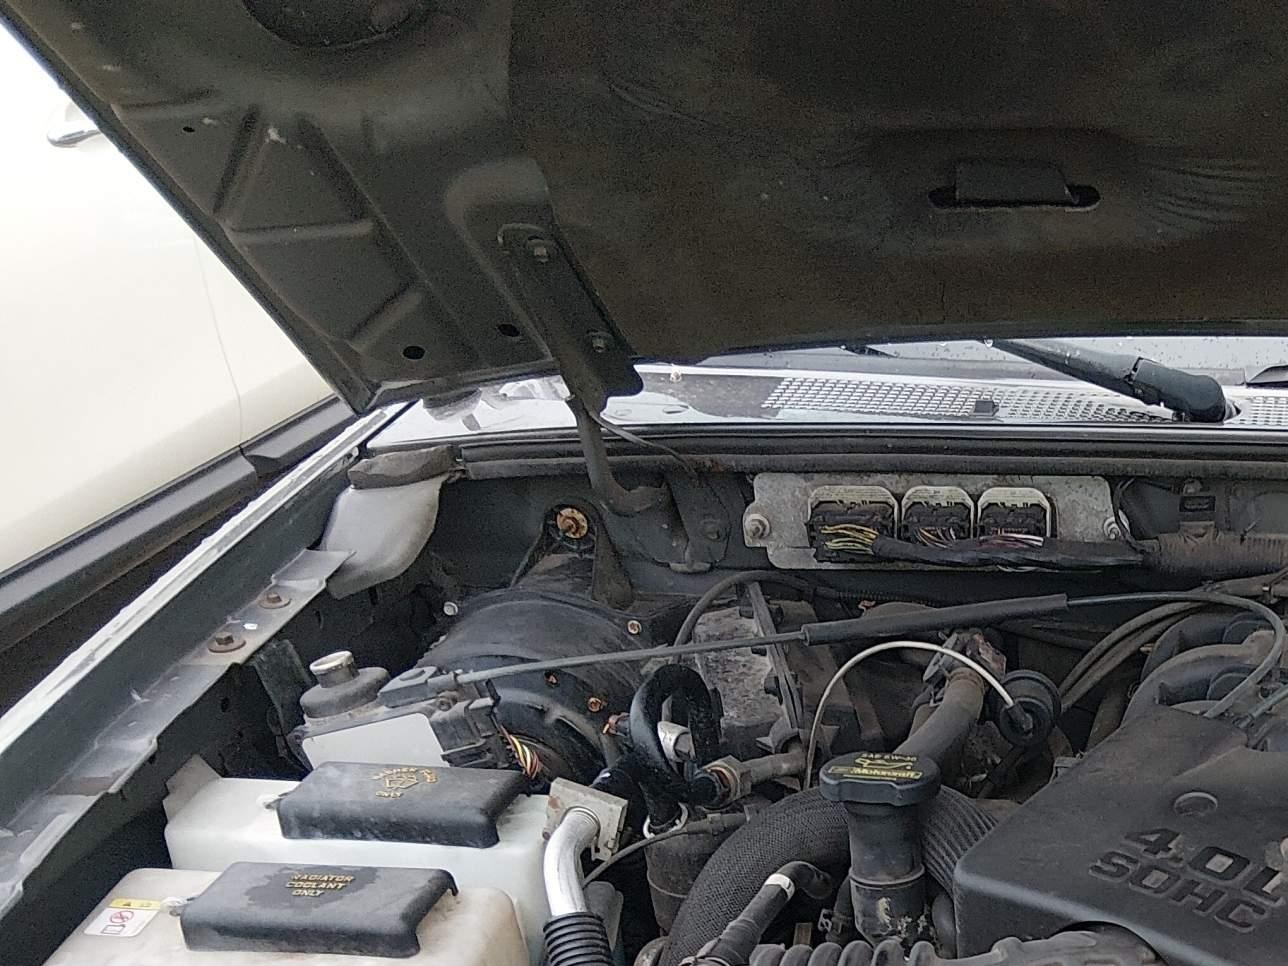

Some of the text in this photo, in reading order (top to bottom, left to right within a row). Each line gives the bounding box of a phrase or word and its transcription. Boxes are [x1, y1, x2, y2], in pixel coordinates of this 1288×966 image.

[285, 881, 347, 890] COOLANT
[1122, 828, 1285, 907] 4.0L
[291, 889, 325, 897] ONLY
[1089, 850, 1269, 933] SOHC
